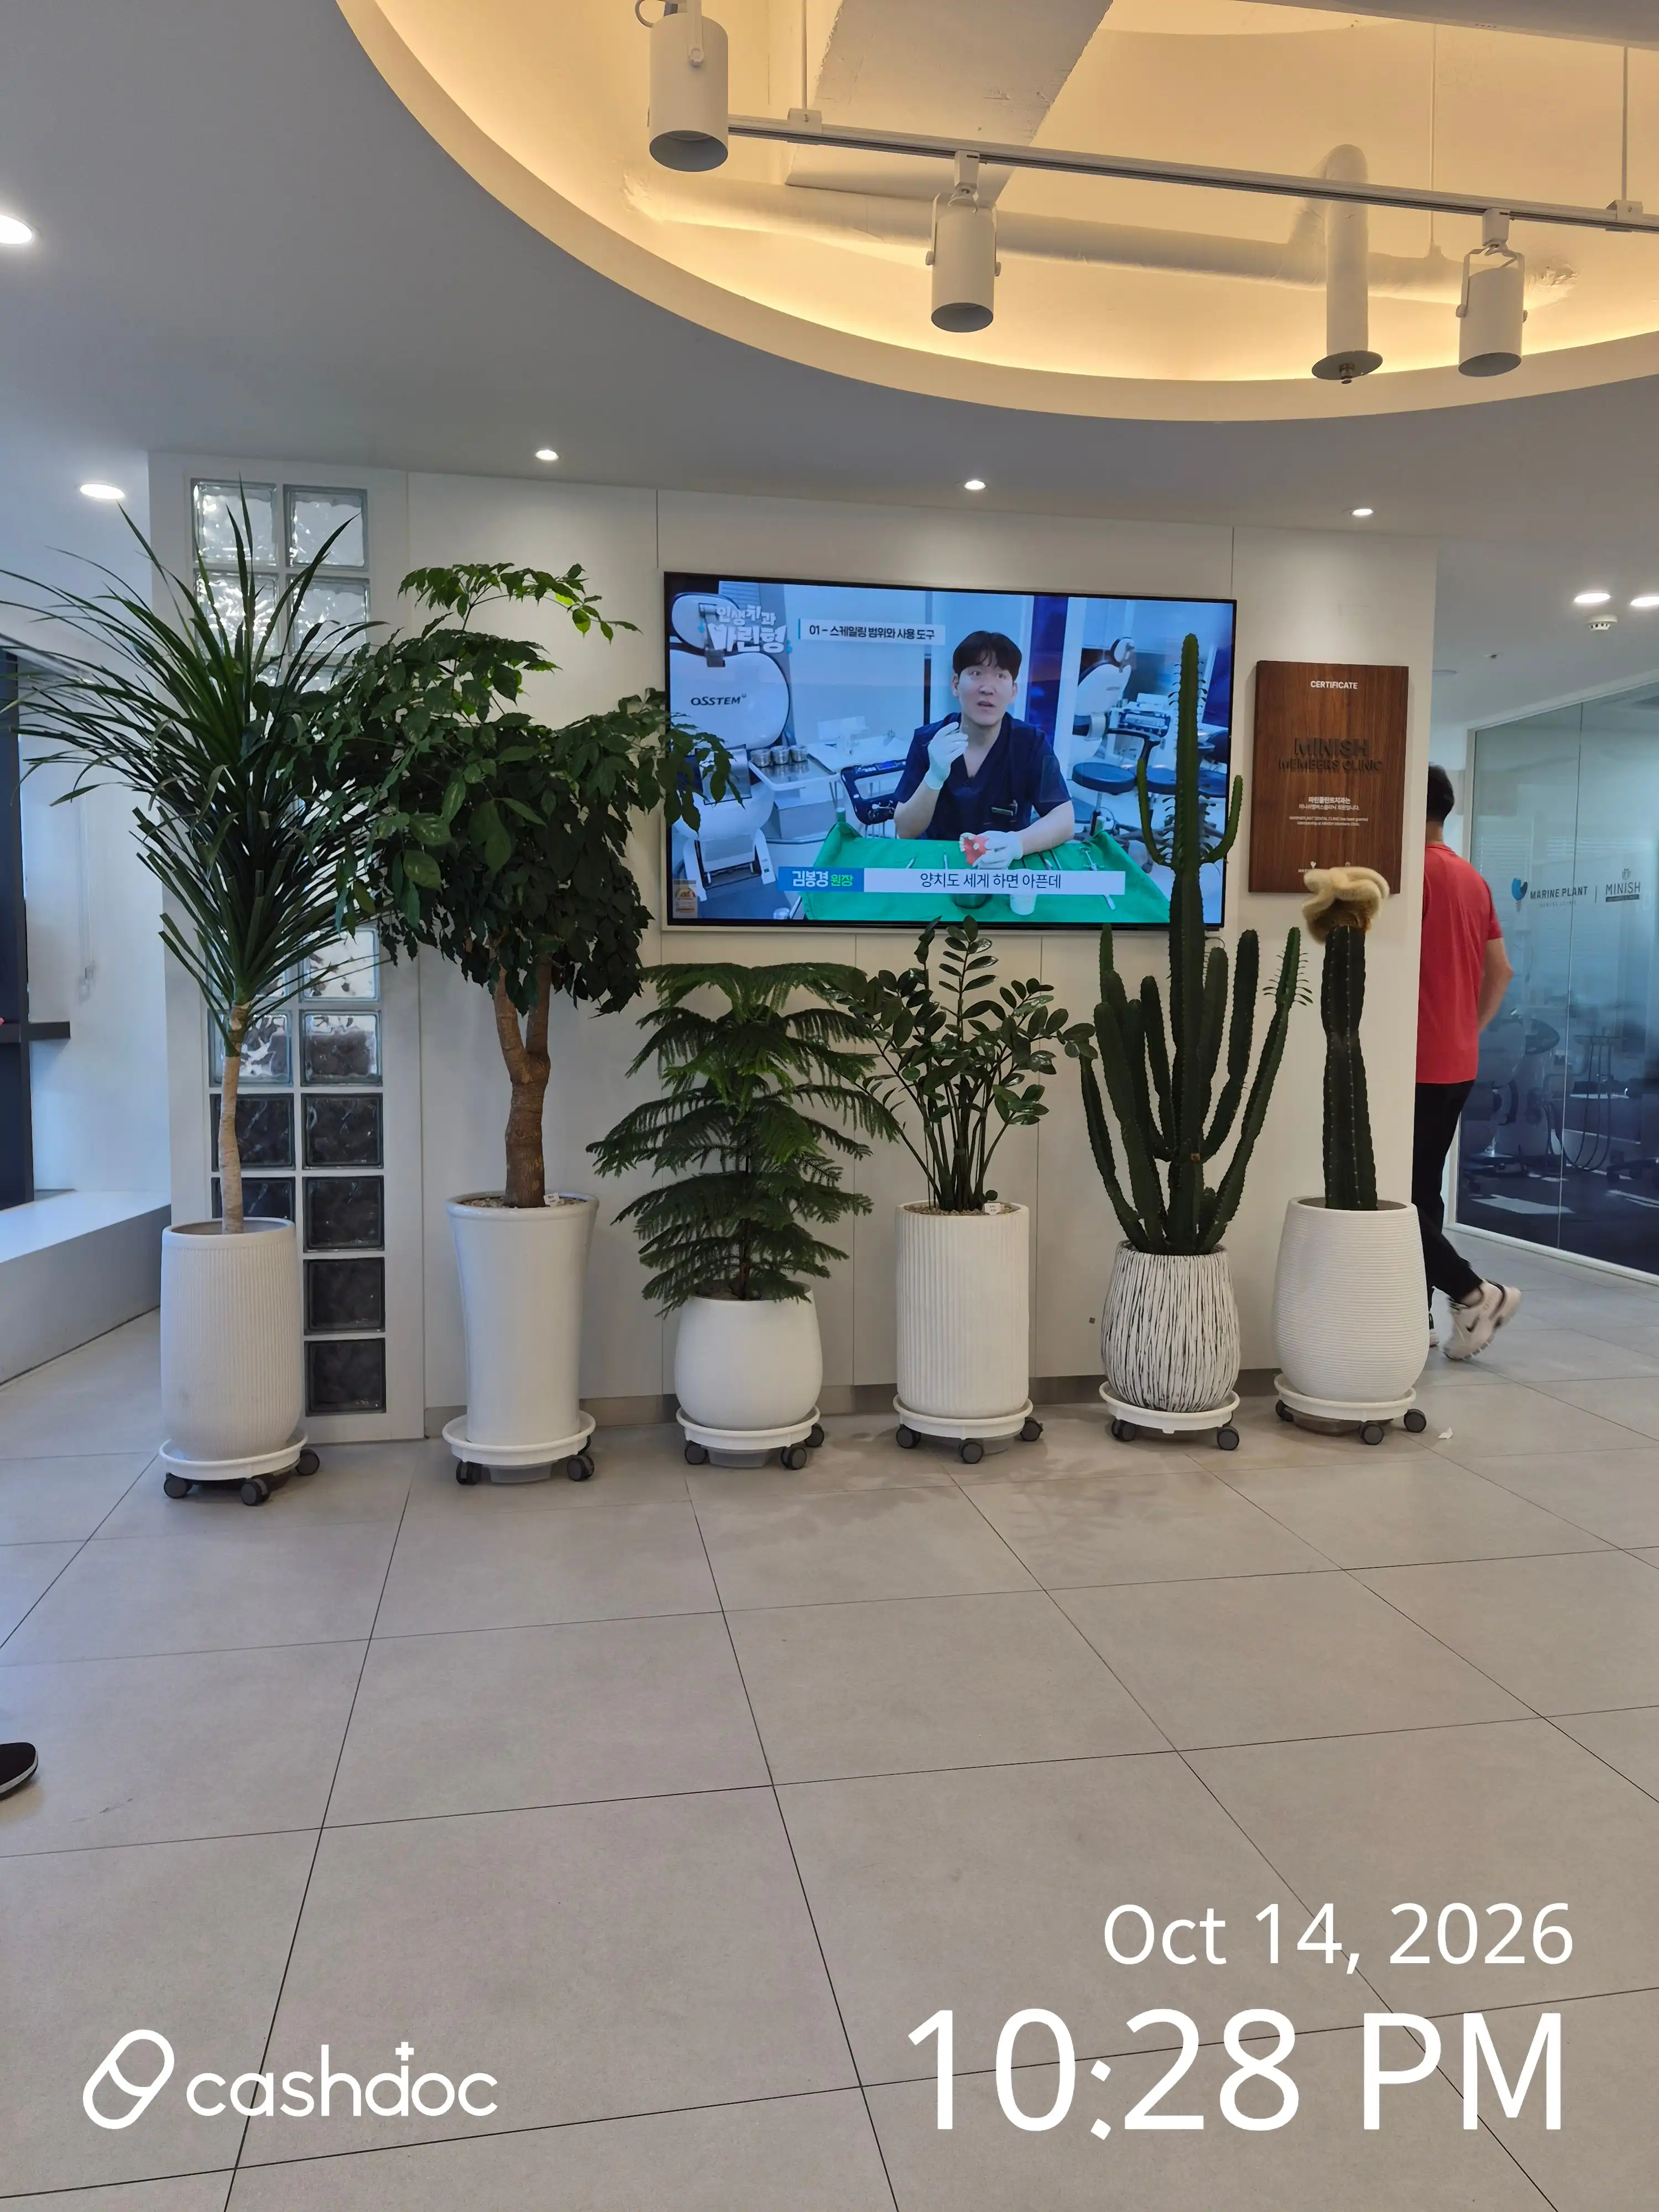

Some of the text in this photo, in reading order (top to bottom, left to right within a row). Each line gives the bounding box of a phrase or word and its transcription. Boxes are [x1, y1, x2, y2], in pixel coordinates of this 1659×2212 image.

[716, 604, 776, 626] 인생치과
[810, 625, 820, 635] 01
[830, 625, 867, 638] 스케일링
[868, 627, 896, 639] 범위와
[897, 628, 915, 640] 사용
[916, 629, 935, 640] 도구
[1310, 680, 1358, 690] CERTIFICATE
[1295, 738, 1370, 757] MINISH
[1279, 758, 1383, 771] MEMBERS CLINIC
[792, 870, 853, 887] 김봉경 원장
[920, 873, 1061, 889] 양치도 세게 하면 아픈데
[1530, 886, 1588, 900] MARINE PLANT
[1606, 881, 1641, 895] MINISH
